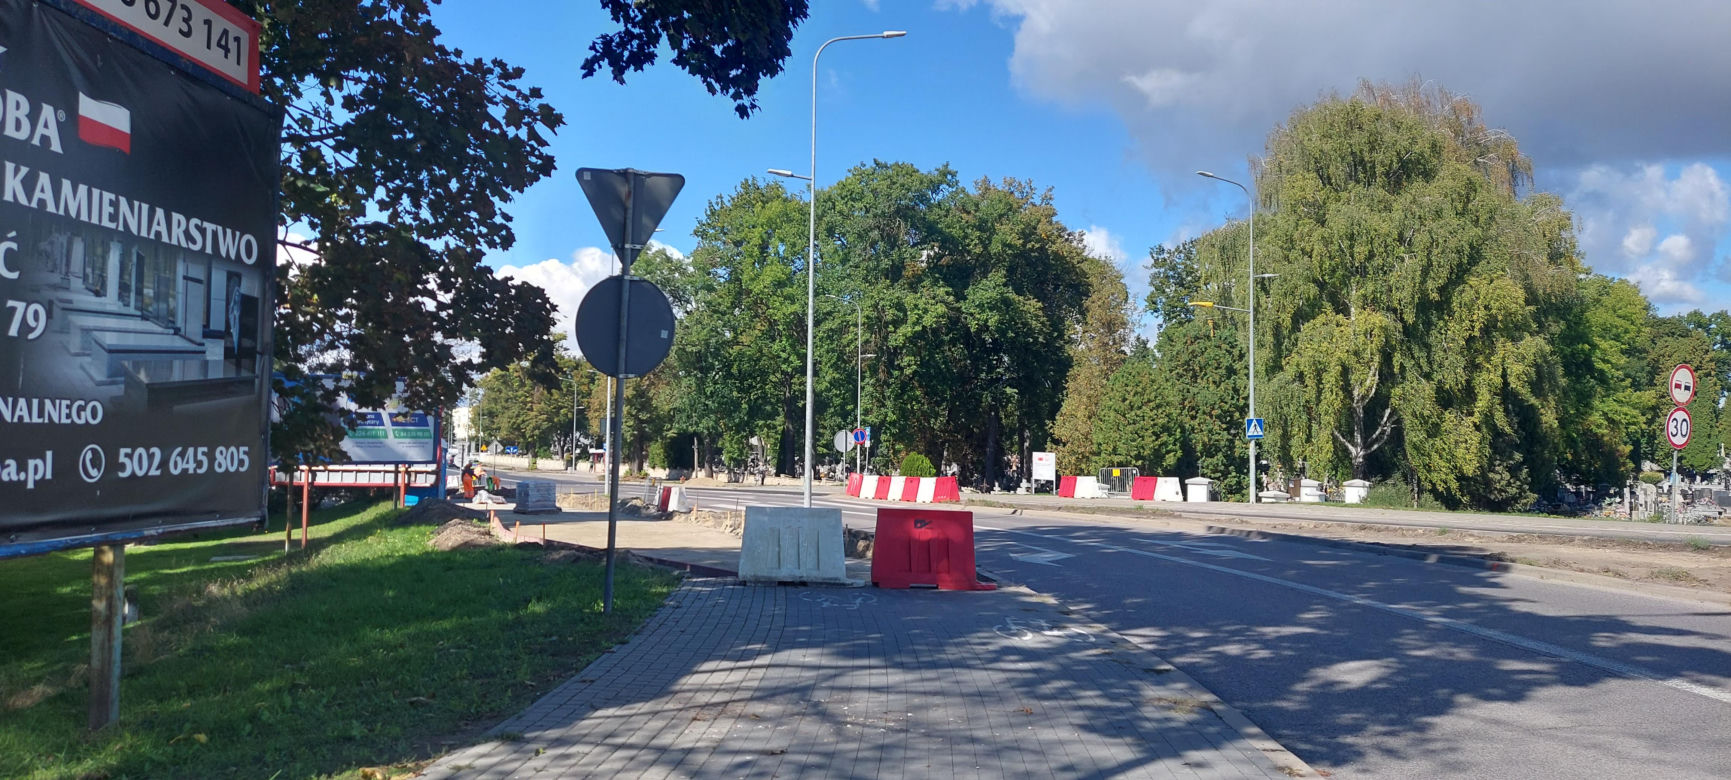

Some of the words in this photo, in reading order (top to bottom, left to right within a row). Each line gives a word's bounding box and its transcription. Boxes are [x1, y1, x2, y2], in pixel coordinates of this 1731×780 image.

[203, 18, 242, 66] 141
[4, 160, 258, 265] KAMIENIARSTWO
[6, 299, 47, 340] 79
[1670, 417, 1689, 439] 30
[0, 450, 53, 489] a.pl
[117, 448, 161, 478] 502
[168, 446, 209, 475] 645
[214, 446, 249, 473] 805
